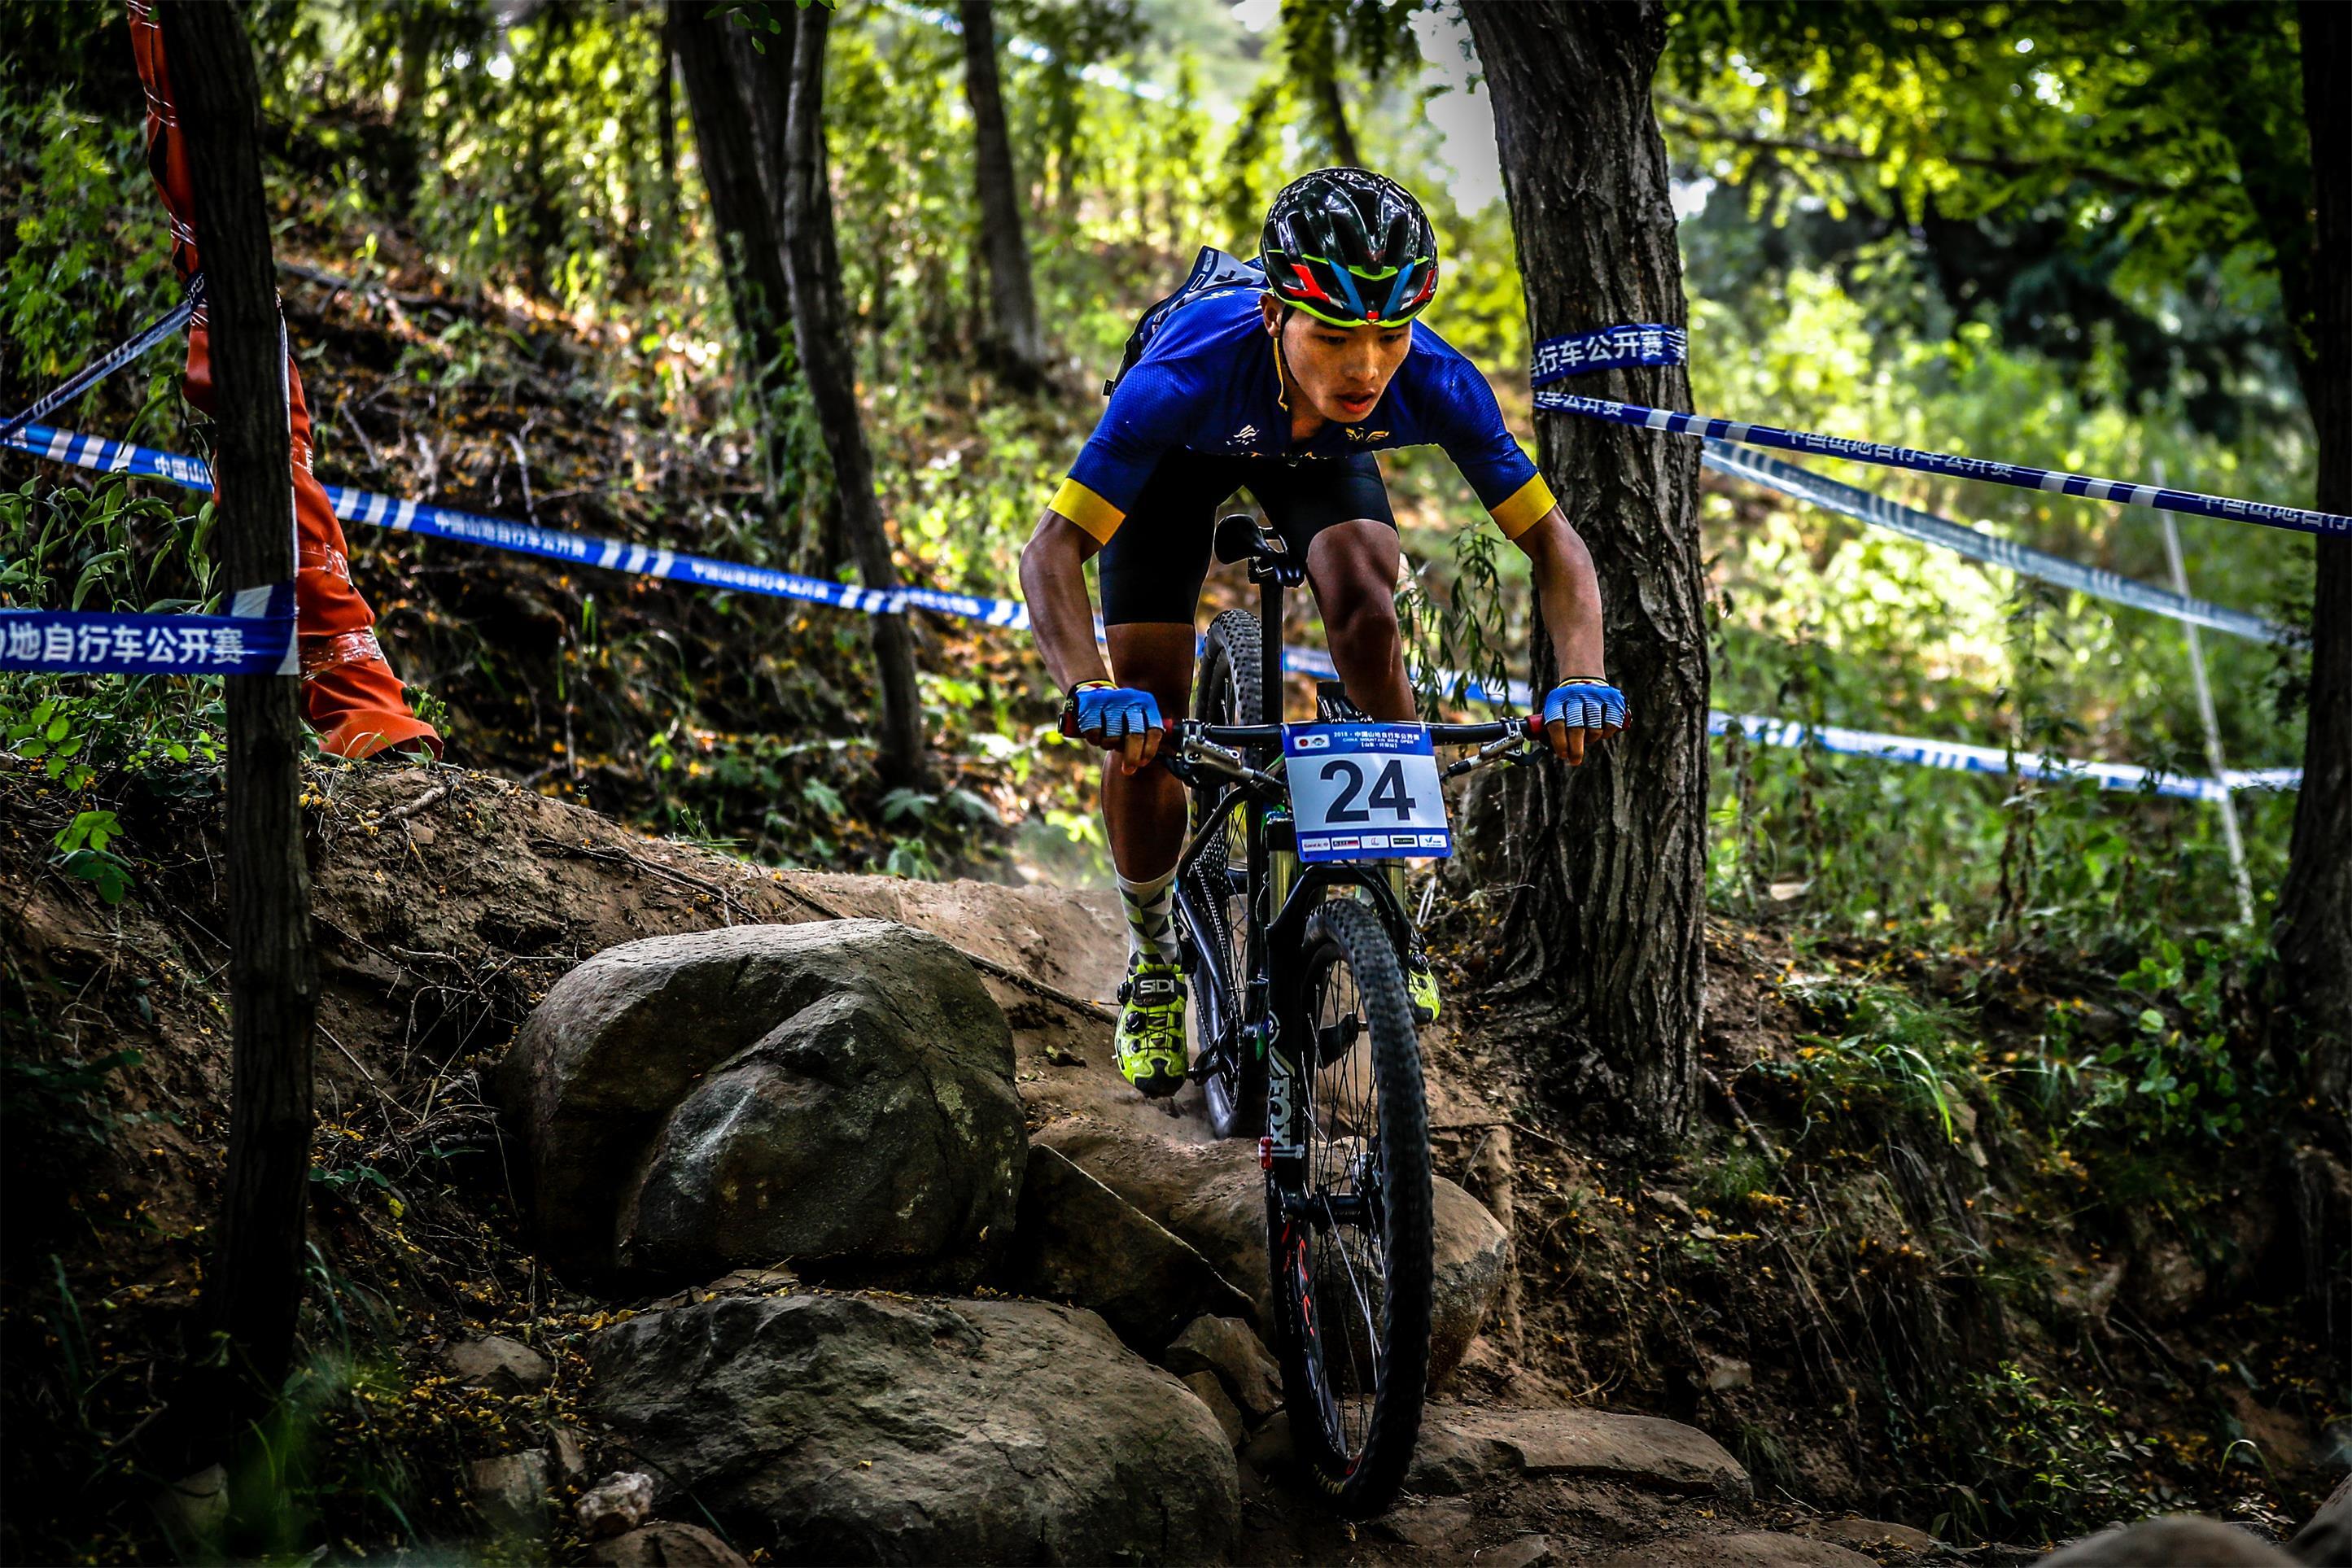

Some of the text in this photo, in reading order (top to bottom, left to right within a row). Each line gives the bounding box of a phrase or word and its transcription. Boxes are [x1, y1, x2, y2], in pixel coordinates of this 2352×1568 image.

[155, 454, 212, 486] 中国山
[1319, 759, 1416, 823] 24
